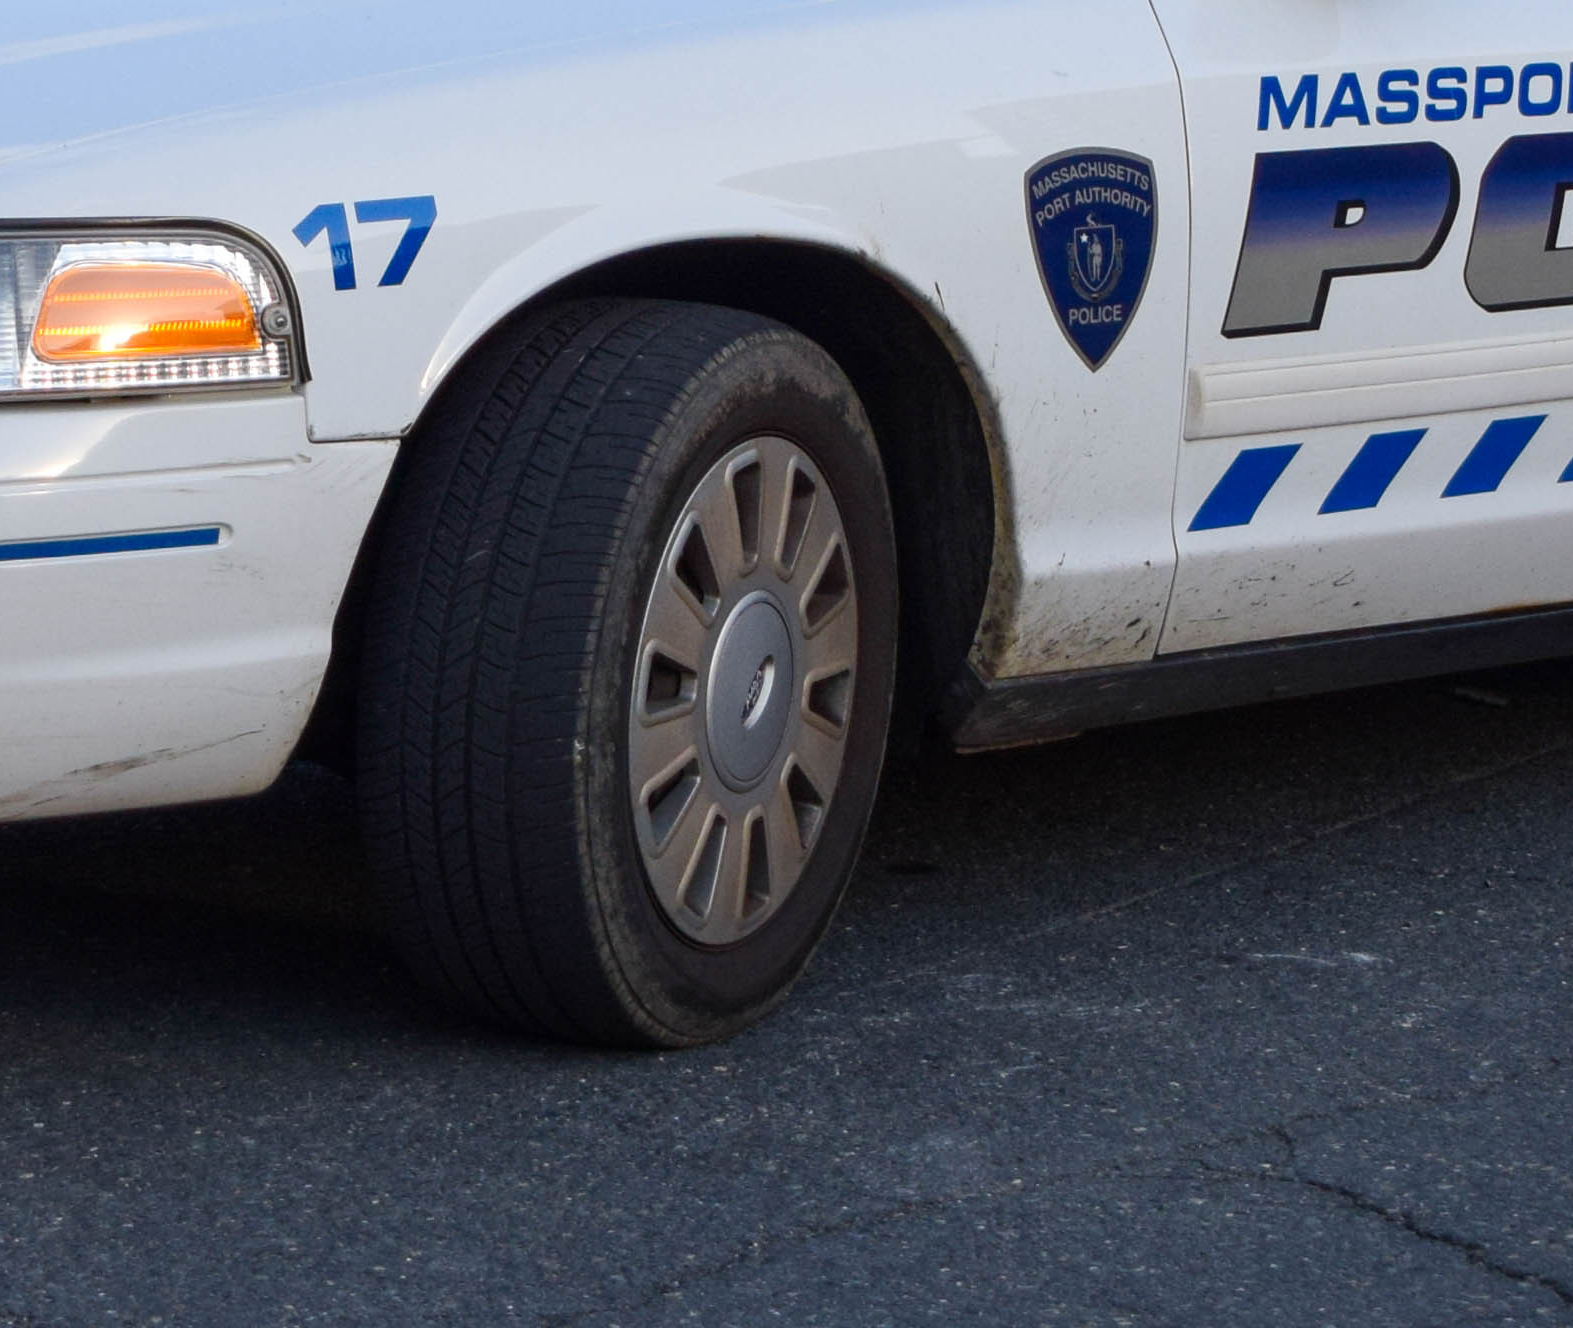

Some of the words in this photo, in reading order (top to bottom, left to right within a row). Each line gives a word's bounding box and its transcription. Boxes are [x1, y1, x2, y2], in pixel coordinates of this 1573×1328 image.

[1032, 161, 1150, 200] MASSACHUSETTS
[1035, 193, 1071, 227] PORT
[1074, 186, 1152, 217] AUTHORITY
[291, 195, 437, 291] 17
[1068, 304, 1123, 326] POLICE
